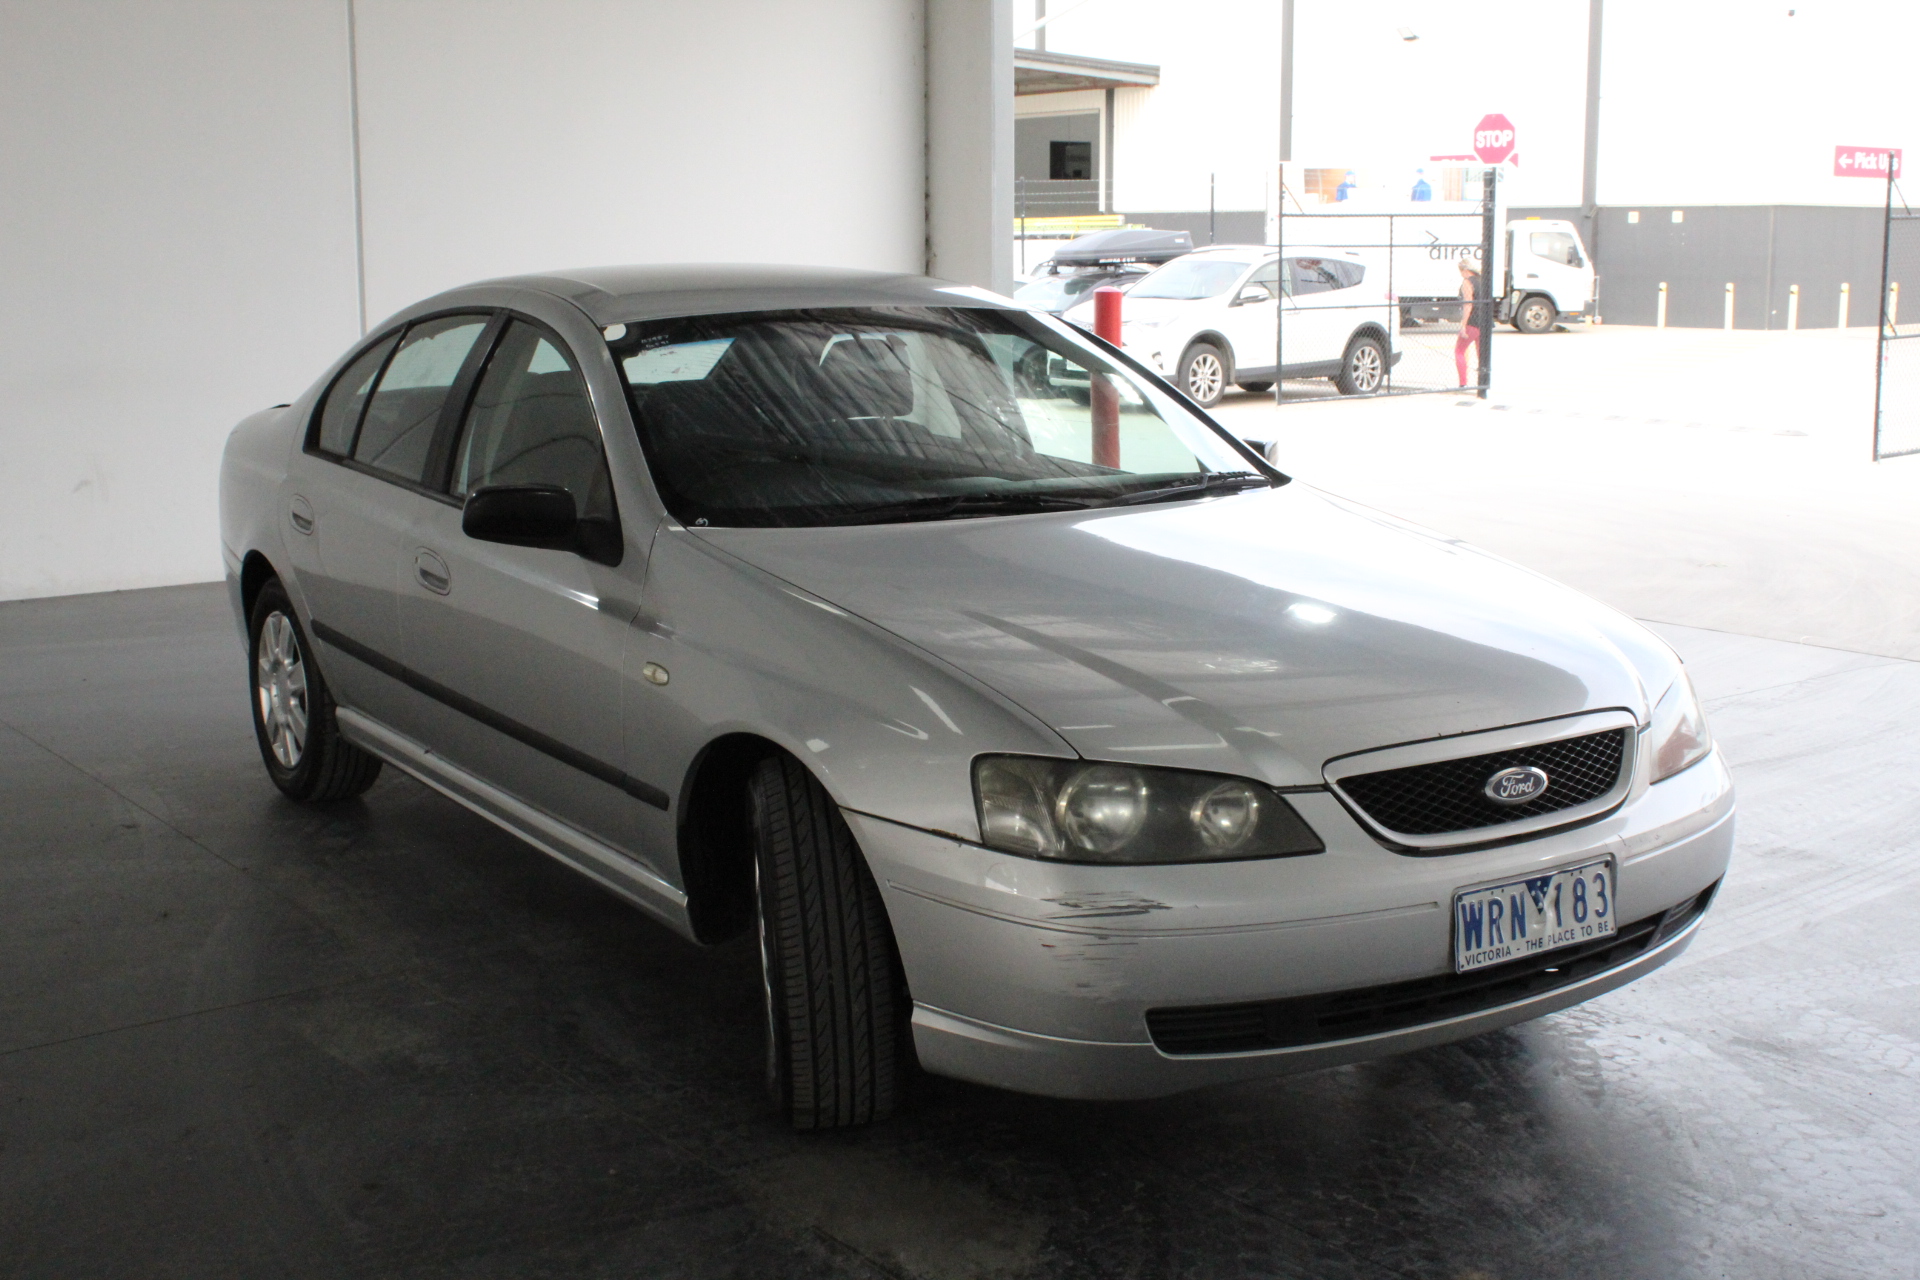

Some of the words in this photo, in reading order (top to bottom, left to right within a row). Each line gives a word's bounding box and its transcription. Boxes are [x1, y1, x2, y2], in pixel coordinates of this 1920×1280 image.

[1476, 129, 1513, 148] STOP
[1854, 152, 1877, 169] Pick
[1500, 773, 1535, 797] Ford
[1460, 890, 1527, 952] WRN
[1554, 872, 1608, 928] 183
[1465, 945, 1512, 966] VICTORIA
[1525, 937, 1543, 951] THE
[1547, 928, 1576, 945] PLACE
[1581, 924, 1593, 936] TO
[1597, 920, 1609, 934] BE
